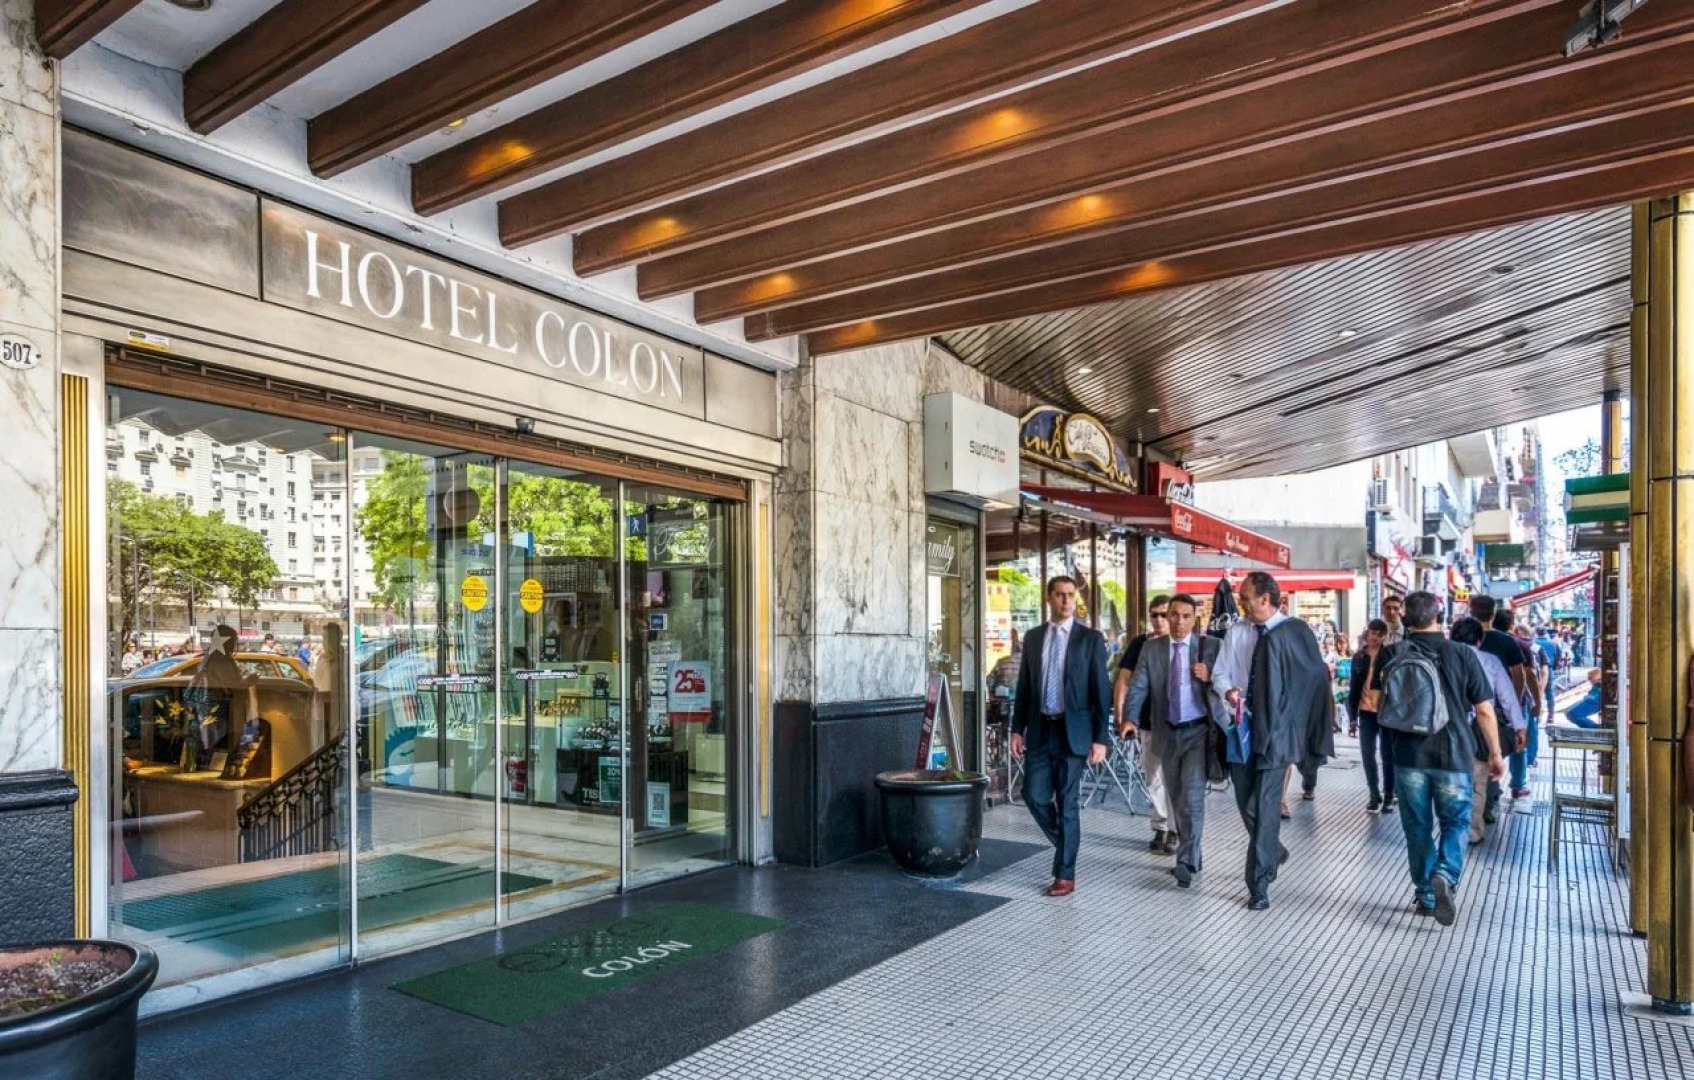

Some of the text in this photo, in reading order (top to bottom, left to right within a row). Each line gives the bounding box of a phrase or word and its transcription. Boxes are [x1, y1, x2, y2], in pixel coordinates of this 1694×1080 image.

[306, 229, 685, 403] HOTEL COLON
[3, 340, 32, 365] 507
[969, 439, 1001, 462] swatch
[582, 787, 598, 799] TIS
[581, 939, 693, 978] COLÓN
